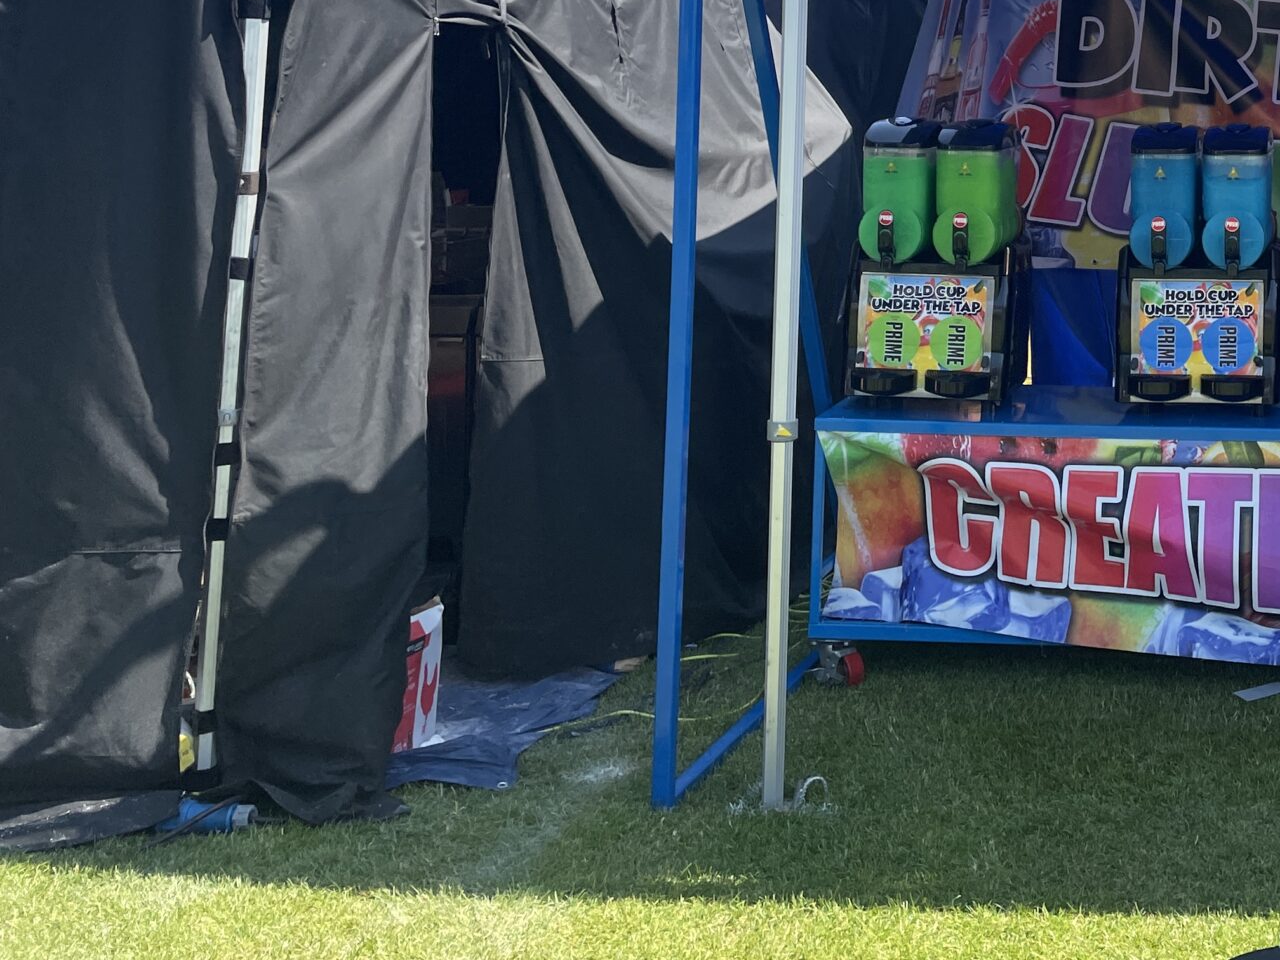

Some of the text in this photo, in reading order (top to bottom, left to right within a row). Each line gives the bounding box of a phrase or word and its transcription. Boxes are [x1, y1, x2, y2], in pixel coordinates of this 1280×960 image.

[892, 283, 967, 299] HOLD CUP
[1165, 289, 1238, 303] HOLD CUP
[871, 298, 982, 315] UNDER THE TAP
[1144, 303, 1254, 318] UNDER THE TAP
[884, 321, 903, 362] PRIME
[947, 324, 966, 366] PRIME
[1157, 326, 1176, 367] PRIME
[1219, 326, 1237, 368] PRIME
